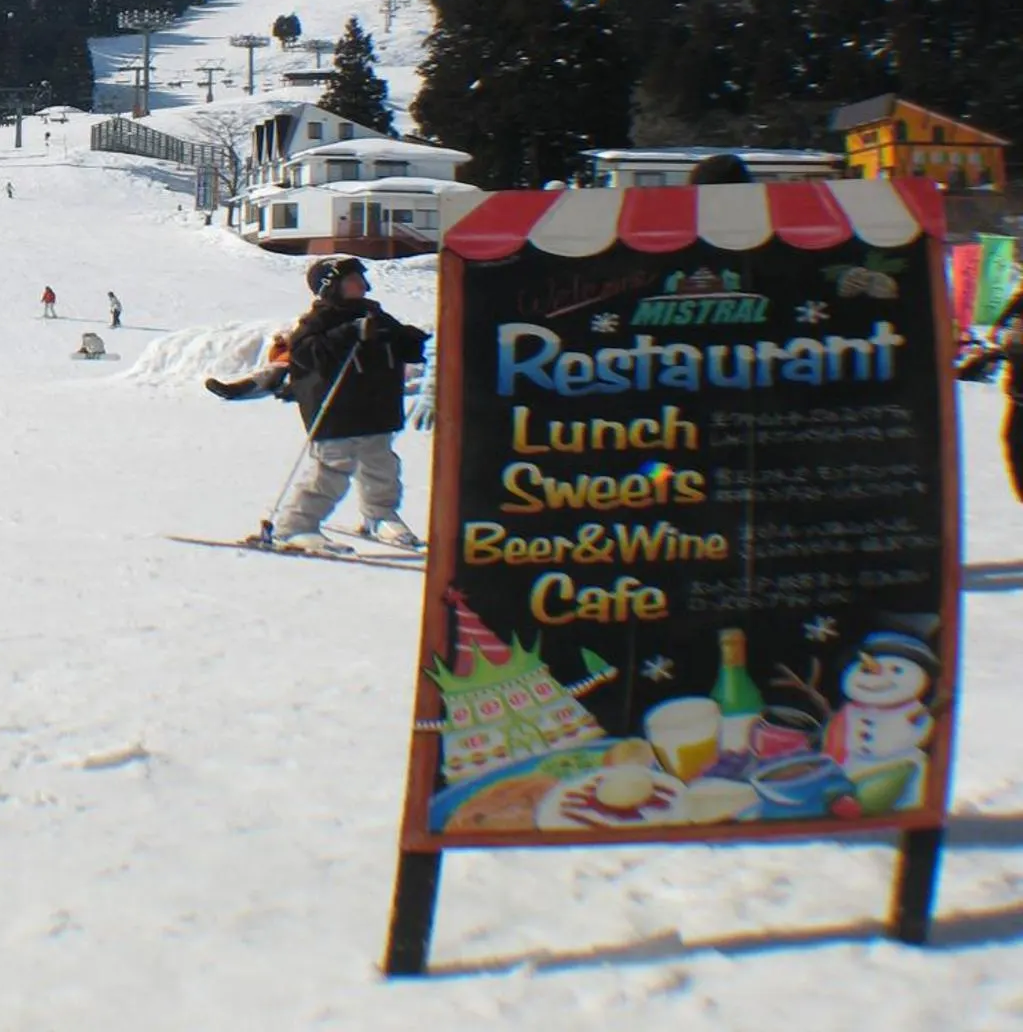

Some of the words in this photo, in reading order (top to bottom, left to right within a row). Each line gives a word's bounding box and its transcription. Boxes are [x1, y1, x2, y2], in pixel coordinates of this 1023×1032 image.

[631, 296, 770, 326] MISTRAL
[497, 321, 904, 396] Restaurant
[512, 406, 698, 454] Lunch
[500, 463, 706, 512] Sweets
[463, 521, 728, 565] Beer&Wine
[531, 572, 668, 624] Cafe
